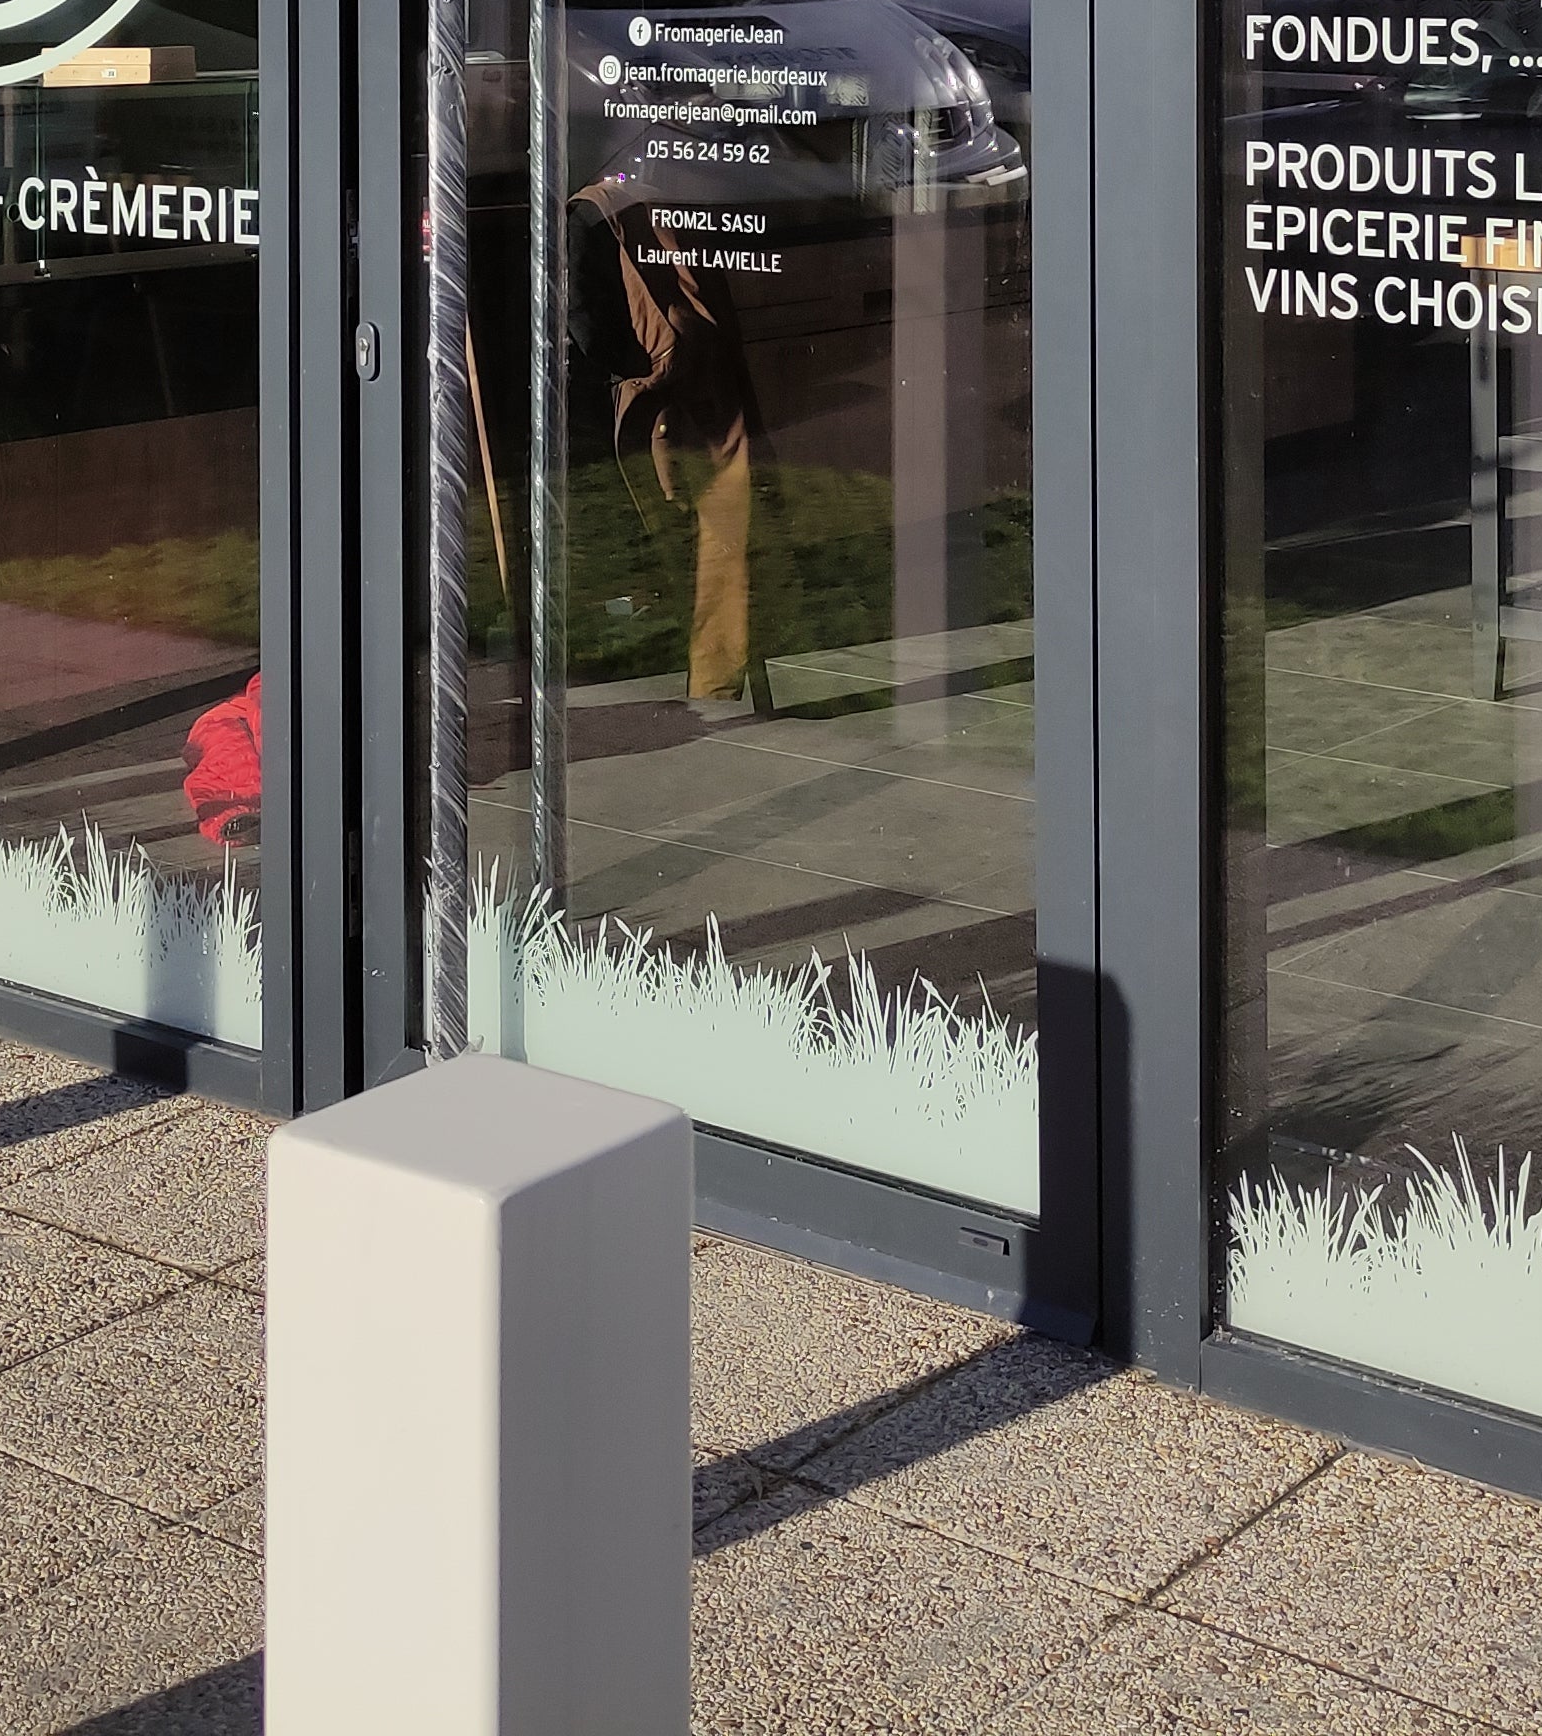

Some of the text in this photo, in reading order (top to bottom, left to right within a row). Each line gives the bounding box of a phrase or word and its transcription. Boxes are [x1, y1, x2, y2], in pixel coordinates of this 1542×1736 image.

[655, 23, 783, 46] FromagerieJean
[1244, 16, 1494, 74] FONDUES,
[623, 62, 828, 87] jean.fromagerie.bordeaux
[603, 100, 817, 127] fromageriejean@gmail.com
[647, 140, 770, 164] 05 56 24 59 62
[1245, 139, 1498, 200] PRODUITS
[18, 165, 259, 245] CRÈMERIE
[651, 208, 766, 234] FROM2L SASU
[1245, 203, 1467, 263] EPICERIE
[637, 244, 782, 274] Laurent LAVIELLE
[1244, 266, 1359, 321] VINS
